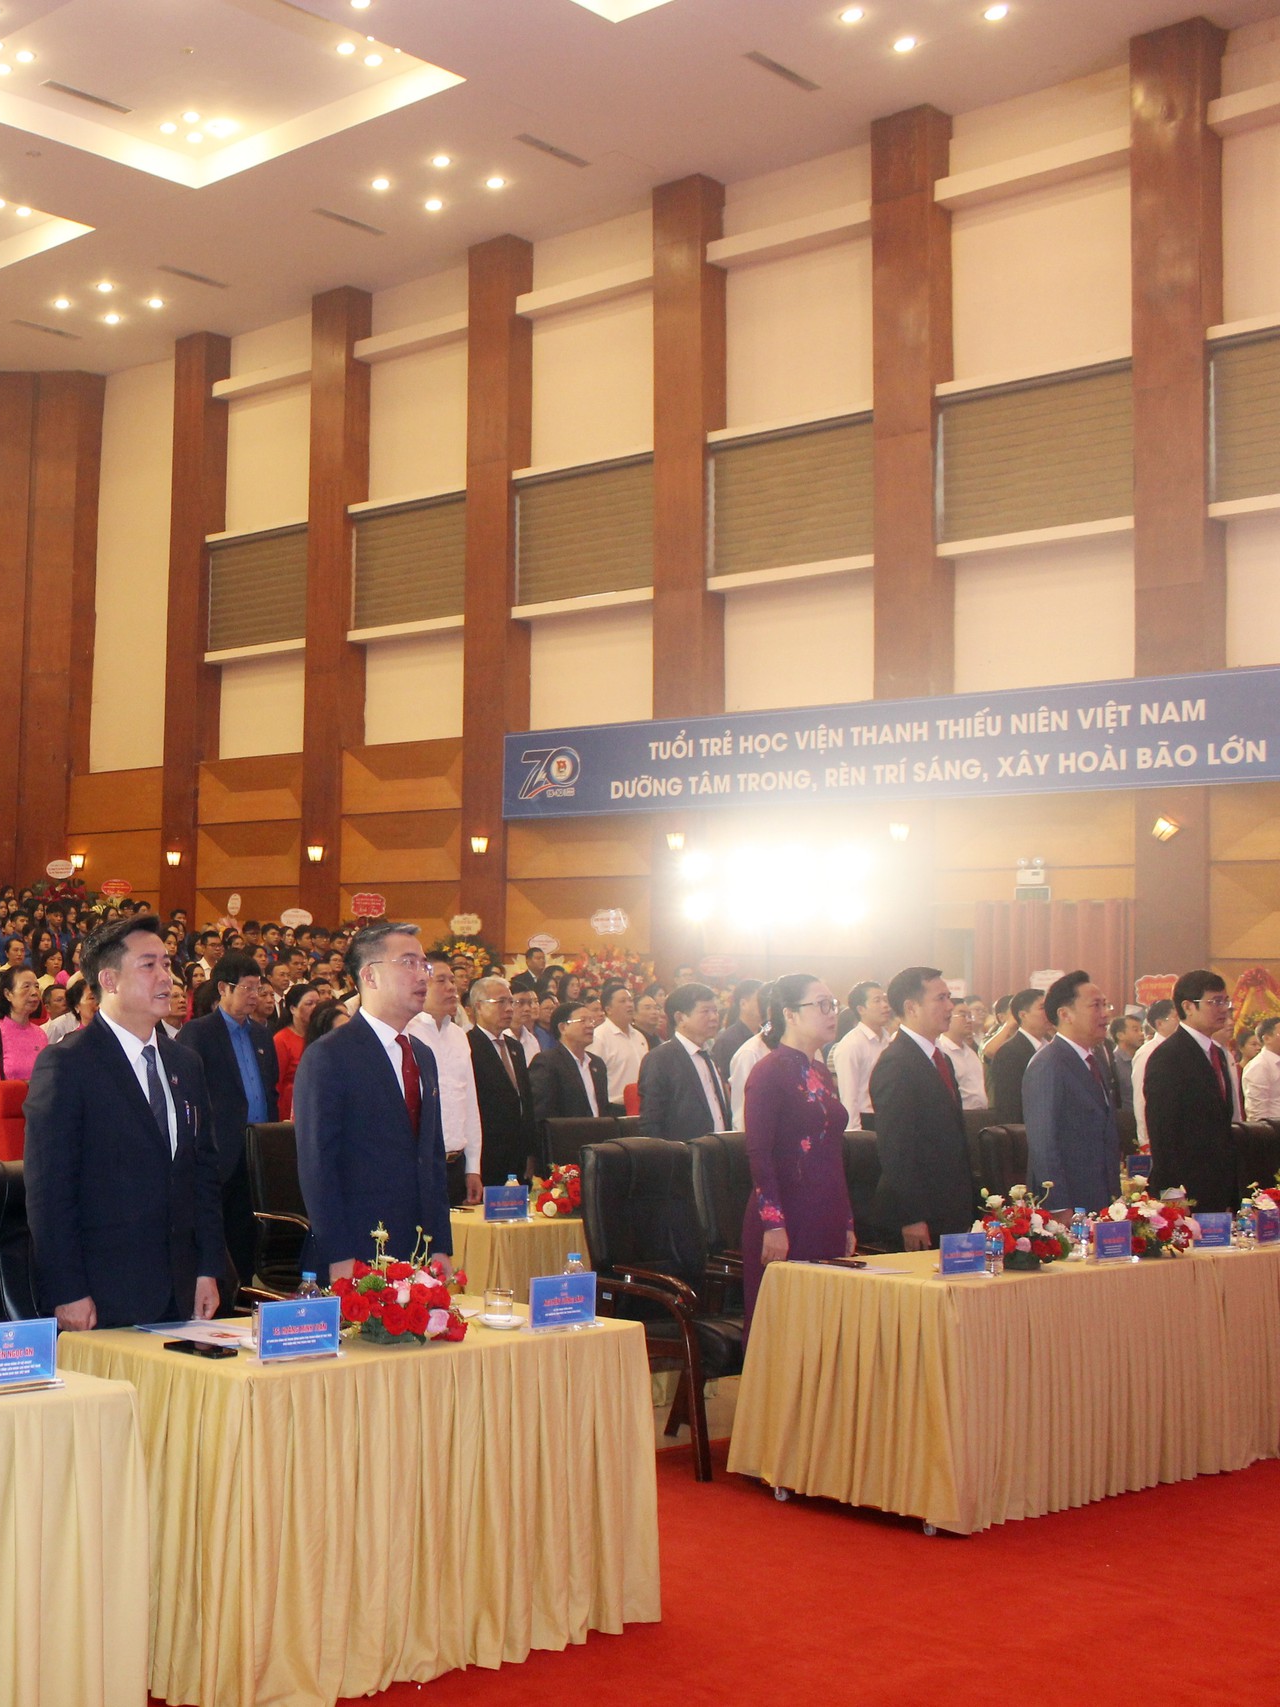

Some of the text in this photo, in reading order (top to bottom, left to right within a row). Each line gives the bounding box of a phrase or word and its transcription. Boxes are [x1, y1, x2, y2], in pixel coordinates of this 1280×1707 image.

[649, 699, 1206, 760] TUỔI TRẺ HỌC VIỆN THANH THIẾU NIÊN VIỆT NAM
[610, 735, 1267, 800] DƯỠNG TÂM TRONG, RÈN TRÍ SÁNG, XÂY HOÀI BÃO LỚN
